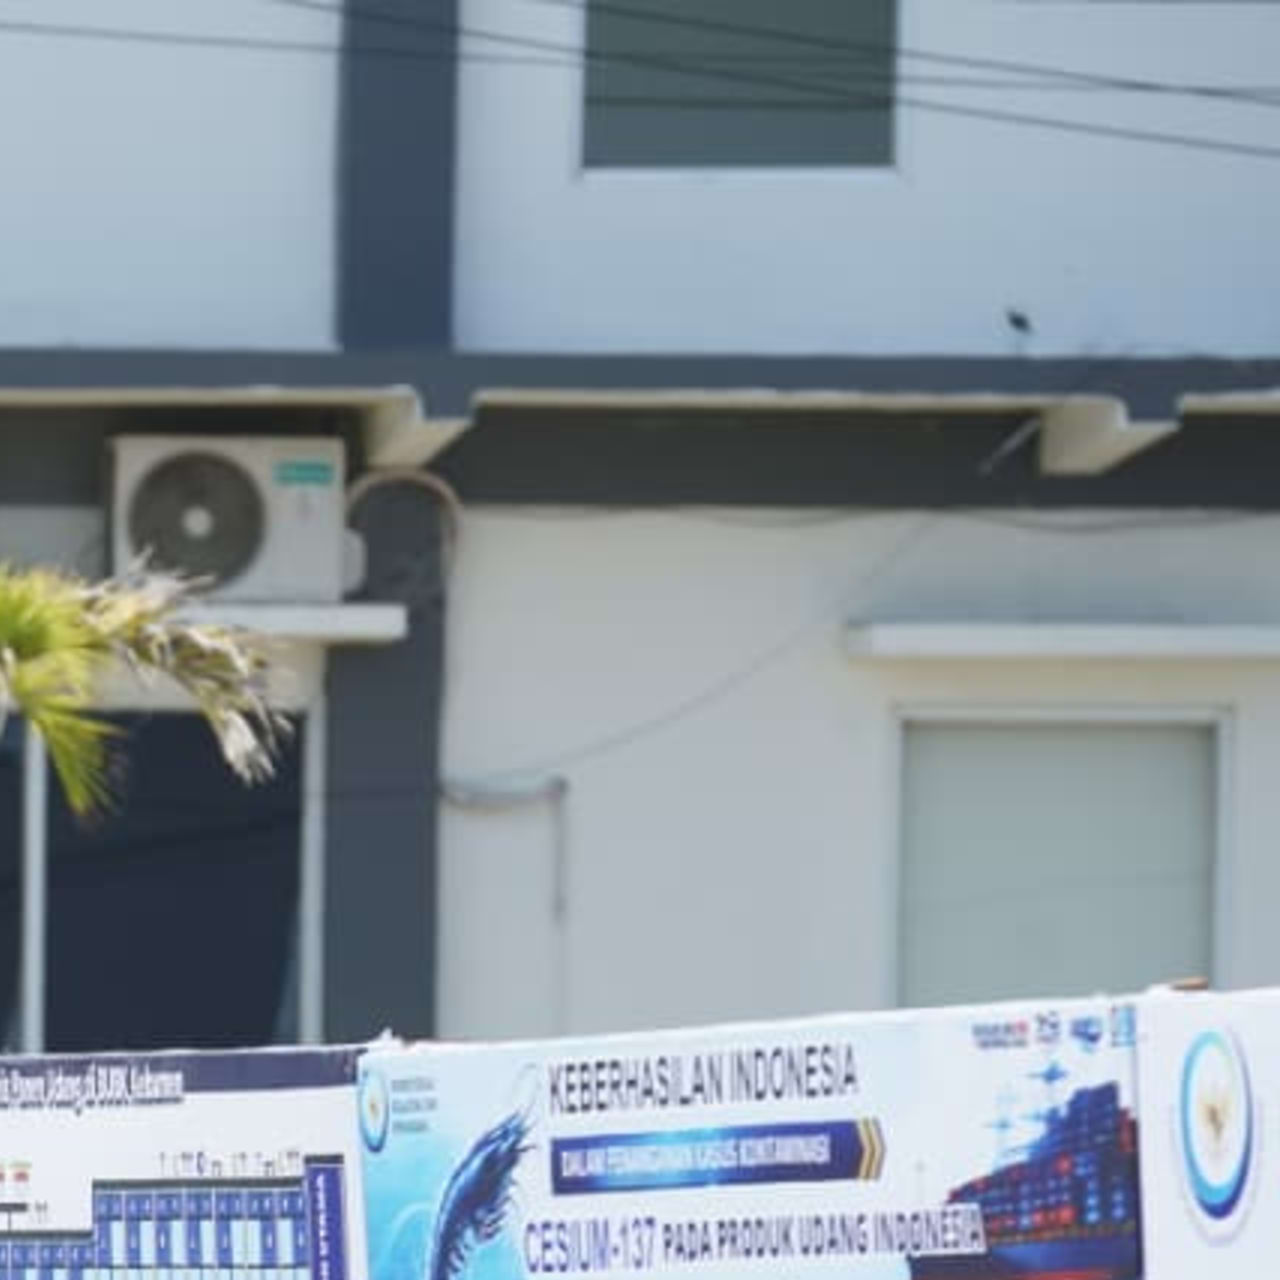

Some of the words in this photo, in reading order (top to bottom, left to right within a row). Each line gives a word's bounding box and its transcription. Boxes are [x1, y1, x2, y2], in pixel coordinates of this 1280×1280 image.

[549, 1052, 727, 1114] KEBERHASILAN
[729, 1045, 858, 1107] INDONESIA
[526, 1217, 656, 1274] CESIUM-137
[663, 1222, 712, 1260] PADA
[717, 1219, 794, 1258] PRODUK
[799, 1215, 868, 1256] UDANG
[873, 1210, 984, 1256] INDONESIA
